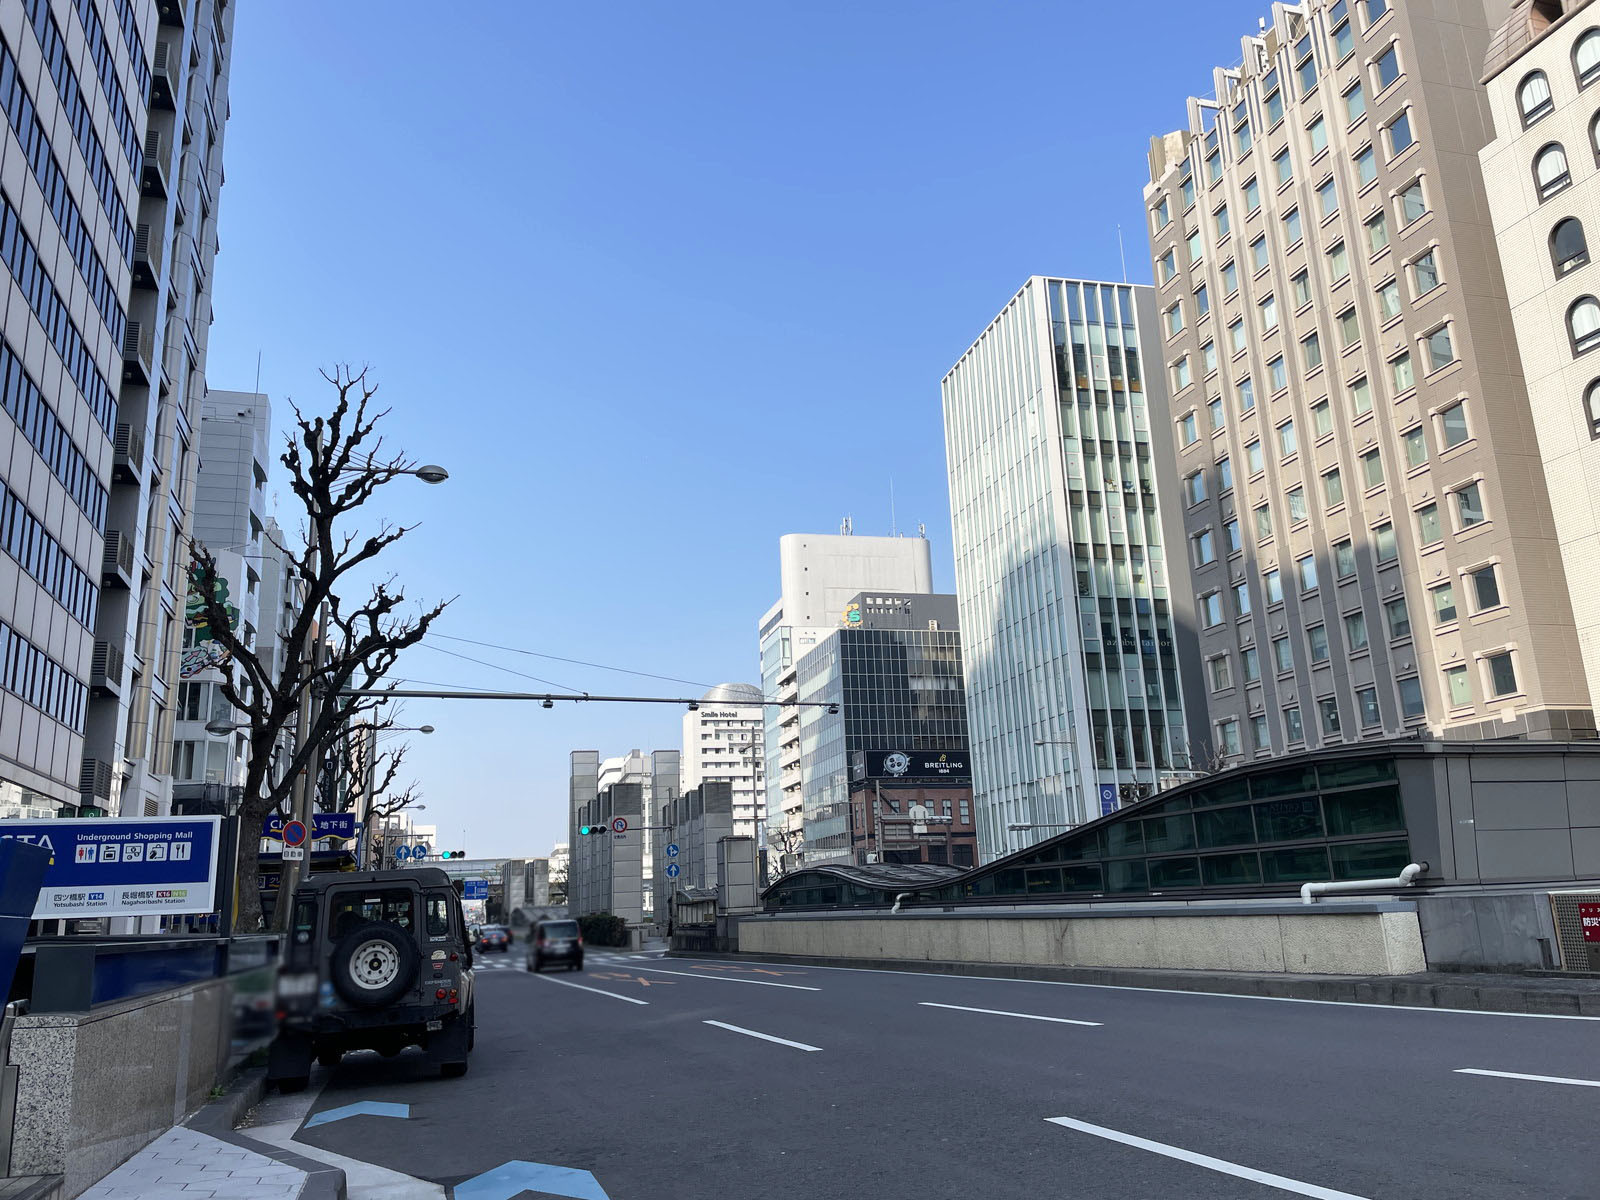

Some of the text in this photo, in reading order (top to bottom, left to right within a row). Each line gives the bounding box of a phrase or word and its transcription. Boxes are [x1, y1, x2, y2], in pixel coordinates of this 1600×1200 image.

[1141, 639, 1171, 647] taior
[320, 821, 348, 829] 地下街
[77, 831, 193, 842] Underground Shopping Mall
[53, 893, 86, 901] 四ツ橋駅
[121, 899, 164, 907] Nagahoribashi
[1583, 917, 1600, 927] 防災
